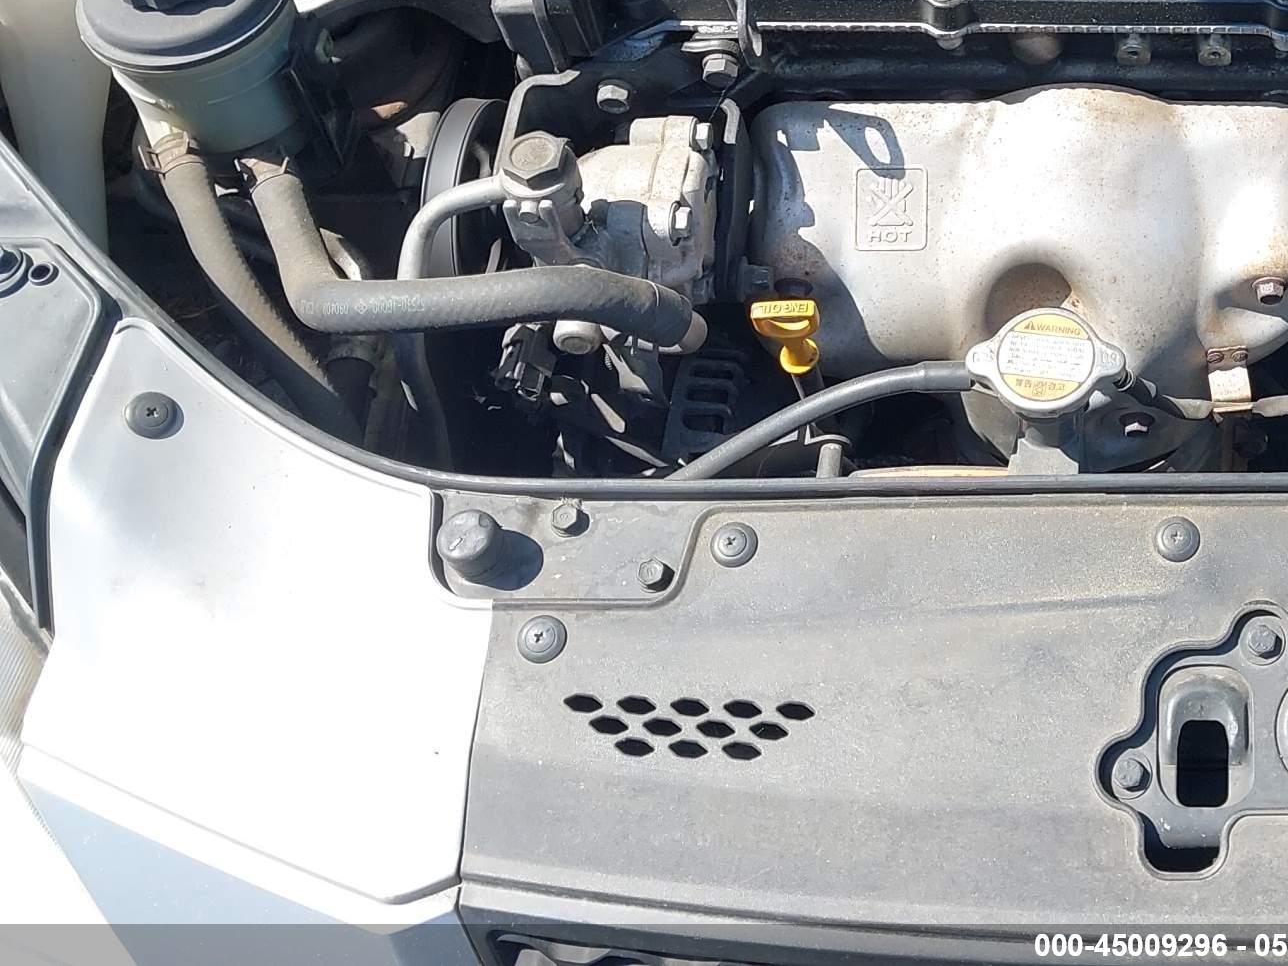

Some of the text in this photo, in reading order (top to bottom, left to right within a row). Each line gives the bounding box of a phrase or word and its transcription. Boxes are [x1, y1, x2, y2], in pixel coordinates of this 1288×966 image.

[869, 231, 913, 244] HOT
[759, 302, 809, 315] ENG OIL
[1036, 322, 1082, 336] WARNING
